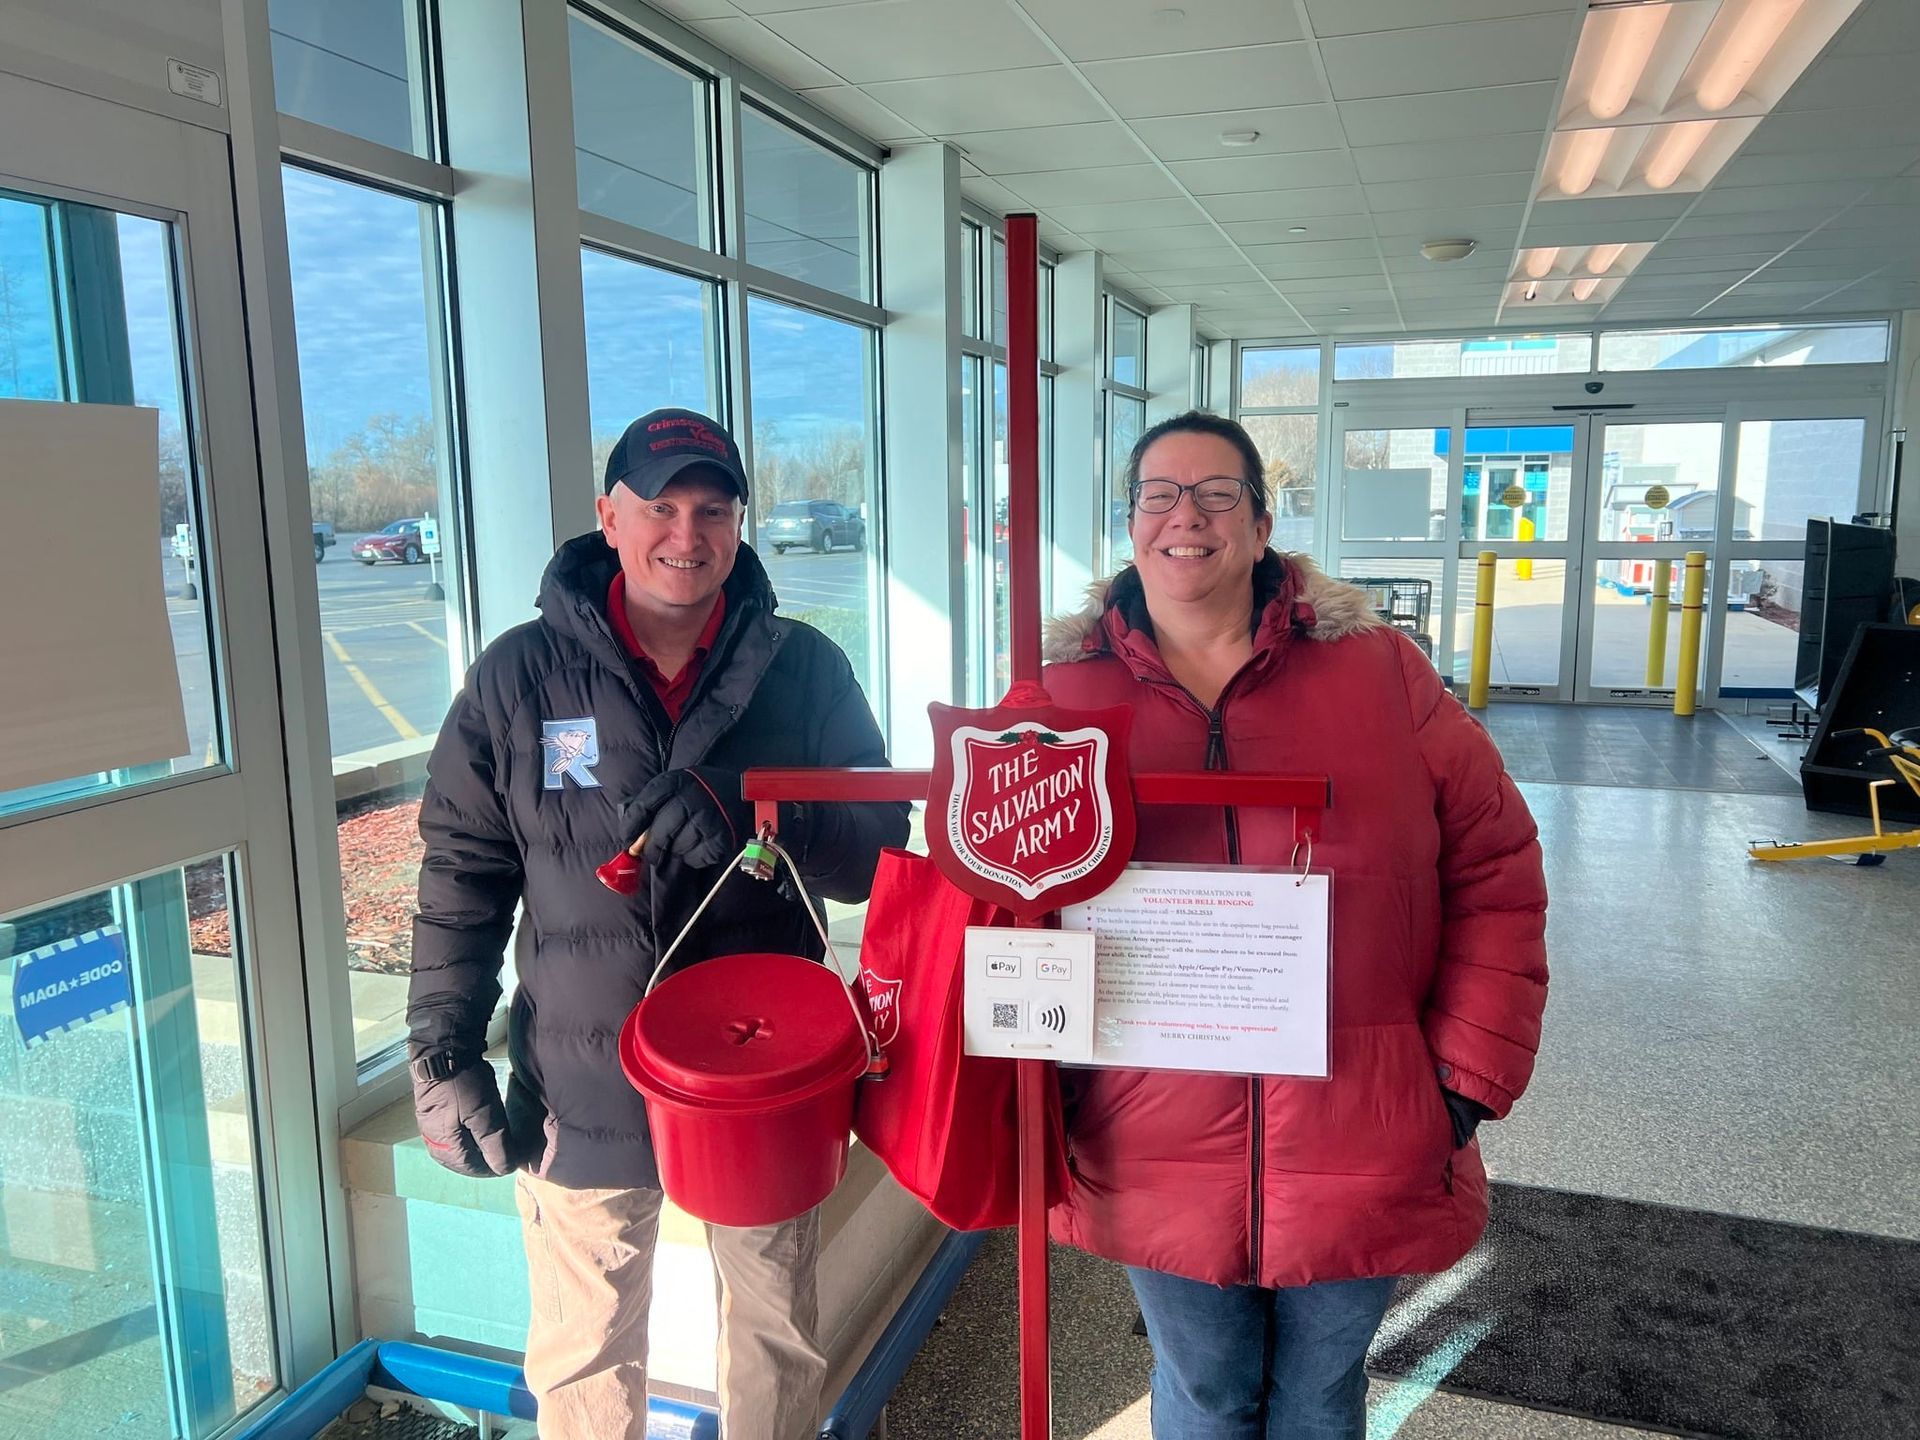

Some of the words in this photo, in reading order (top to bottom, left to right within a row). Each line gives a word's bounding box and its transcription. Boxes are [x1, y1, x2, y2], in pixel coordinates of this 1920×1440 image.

[988, 749, 1039, 795] THE
[951, 793, 960, 821] THANK
[972, 756, 1084, 845] SALVATION
[951, 821, 960, 838] YOU
[1012, 798, 1081, 865] ARMY
[954, 839, 966, 857] FOR
[1061, 864, 1088, 881] MERRY
[1087, 825, 1111, 867] CHRISTMAS
[964, 853, 983, 872] YOUR
[983, 868, 1024, 889] DONATION
[1143, 897, 1193, 905] VOLUNTEER
[1179, 889, 1234, 897] INFORMATION
[999, 962, 1016, 973] Pay
[1041, 964, 1050, 973] G
[1052, 964, 1067, 975] Pay
[1158, 1021, 1195, 1029] volunteering
